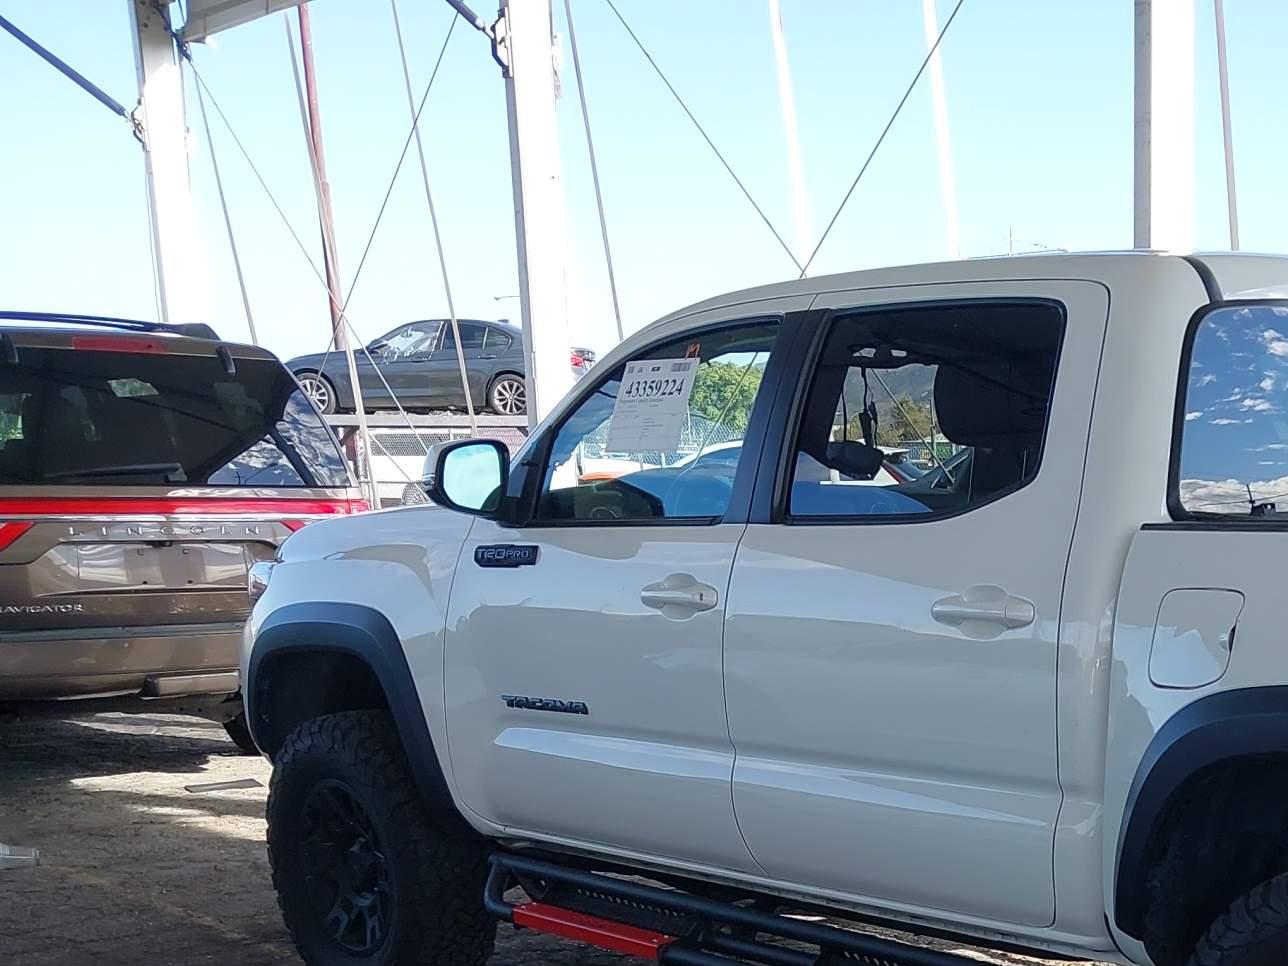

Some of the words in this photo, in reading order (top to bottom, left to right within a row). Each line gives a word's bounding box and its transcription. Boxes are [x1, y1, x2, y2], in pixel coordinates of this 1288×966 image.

[625, 378, 685, 398] 43359224
[69, 525, 260, 536] LINCOLN
[506, 550, 529, 558] PRO
[0, 604, 83, 614] AVIGATOR
